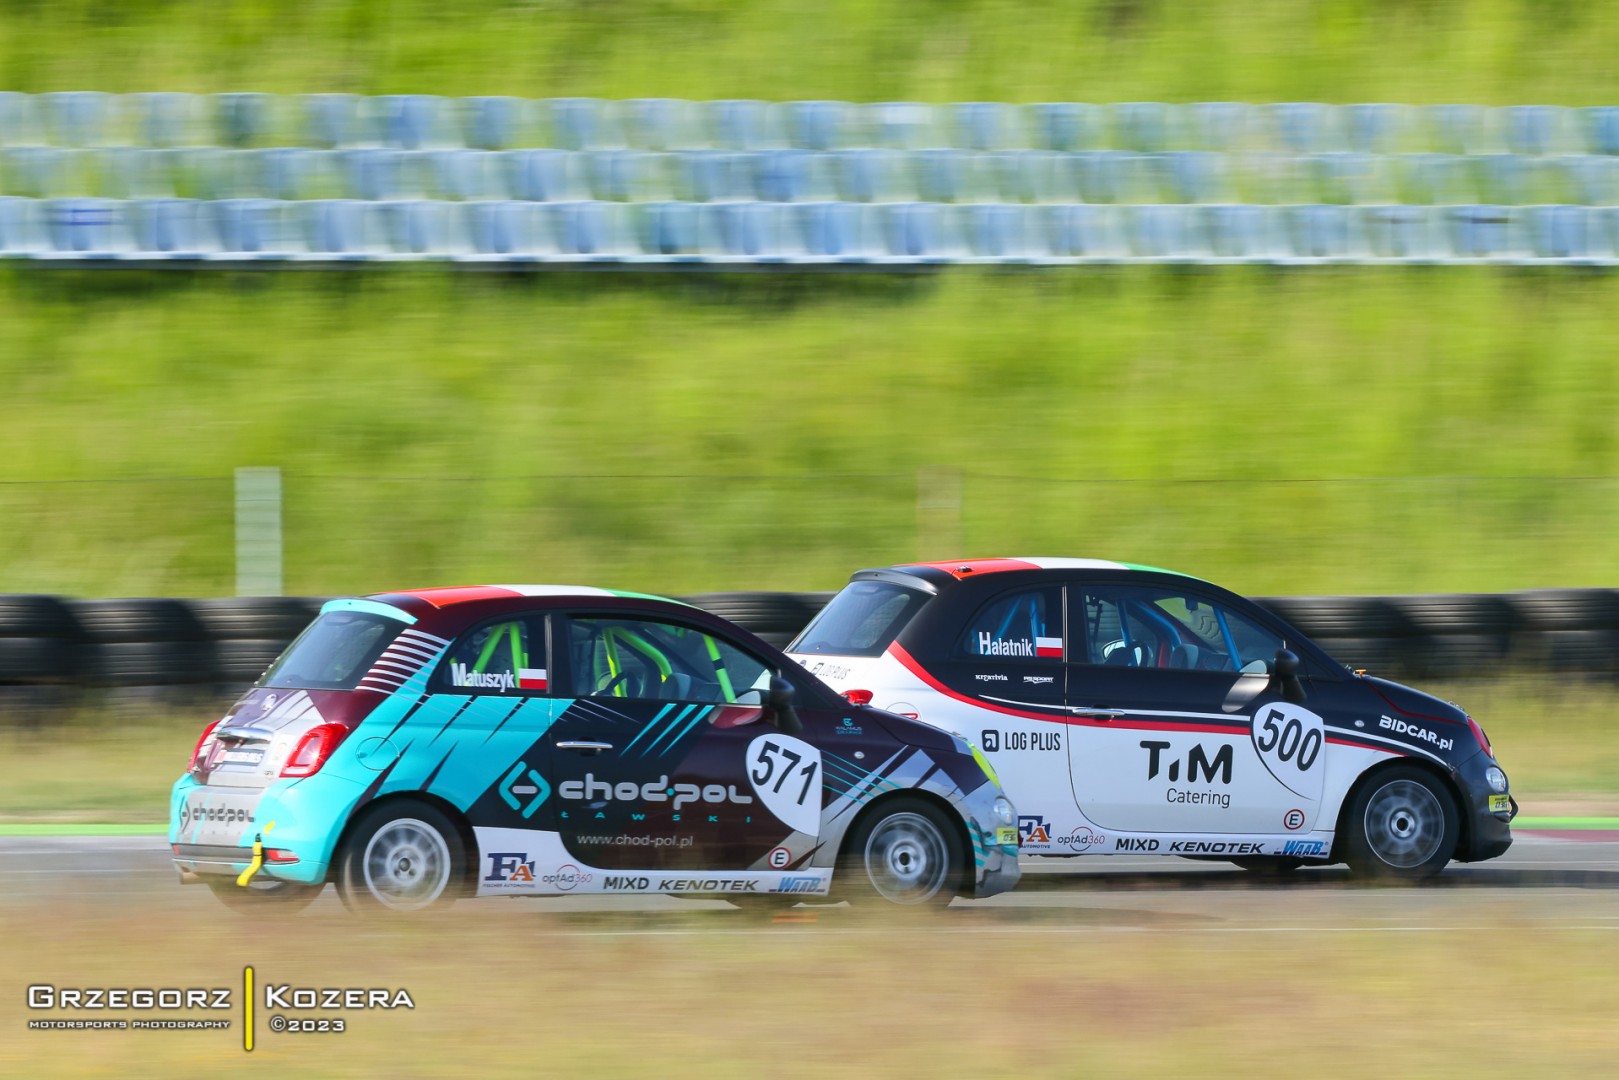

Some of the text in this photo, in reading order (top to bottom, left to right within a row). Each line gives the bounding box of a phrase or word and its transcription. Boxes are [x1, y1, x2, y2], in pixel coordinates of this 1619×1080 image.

[451, 663, 515, 693] Matuszyk
[1379, 714, 1454, 751] BIDCAR.pl
[1004, 732, 1061, 751] LOG PLUS
[1258, 709, 1322, 772] 500
[752, 740, 818, 806] 571
[1166, 787, 1231, 809] Catering
[1289, 813, 1300, 826] E
[577, 834, 693, 848] www.chod-pol.pl
[1057, 835, 1106, 845] optAd360
[1115, 838, 1160, 852] MIXD
[1169, 841, 1266, 854] KENOTEK
[774, 852, 785, 865] E
[542, 873, 593, 884] optAd360
[602, 876, 650, 891] MIXD
[658, 879, 761, 892] KENOTEK
